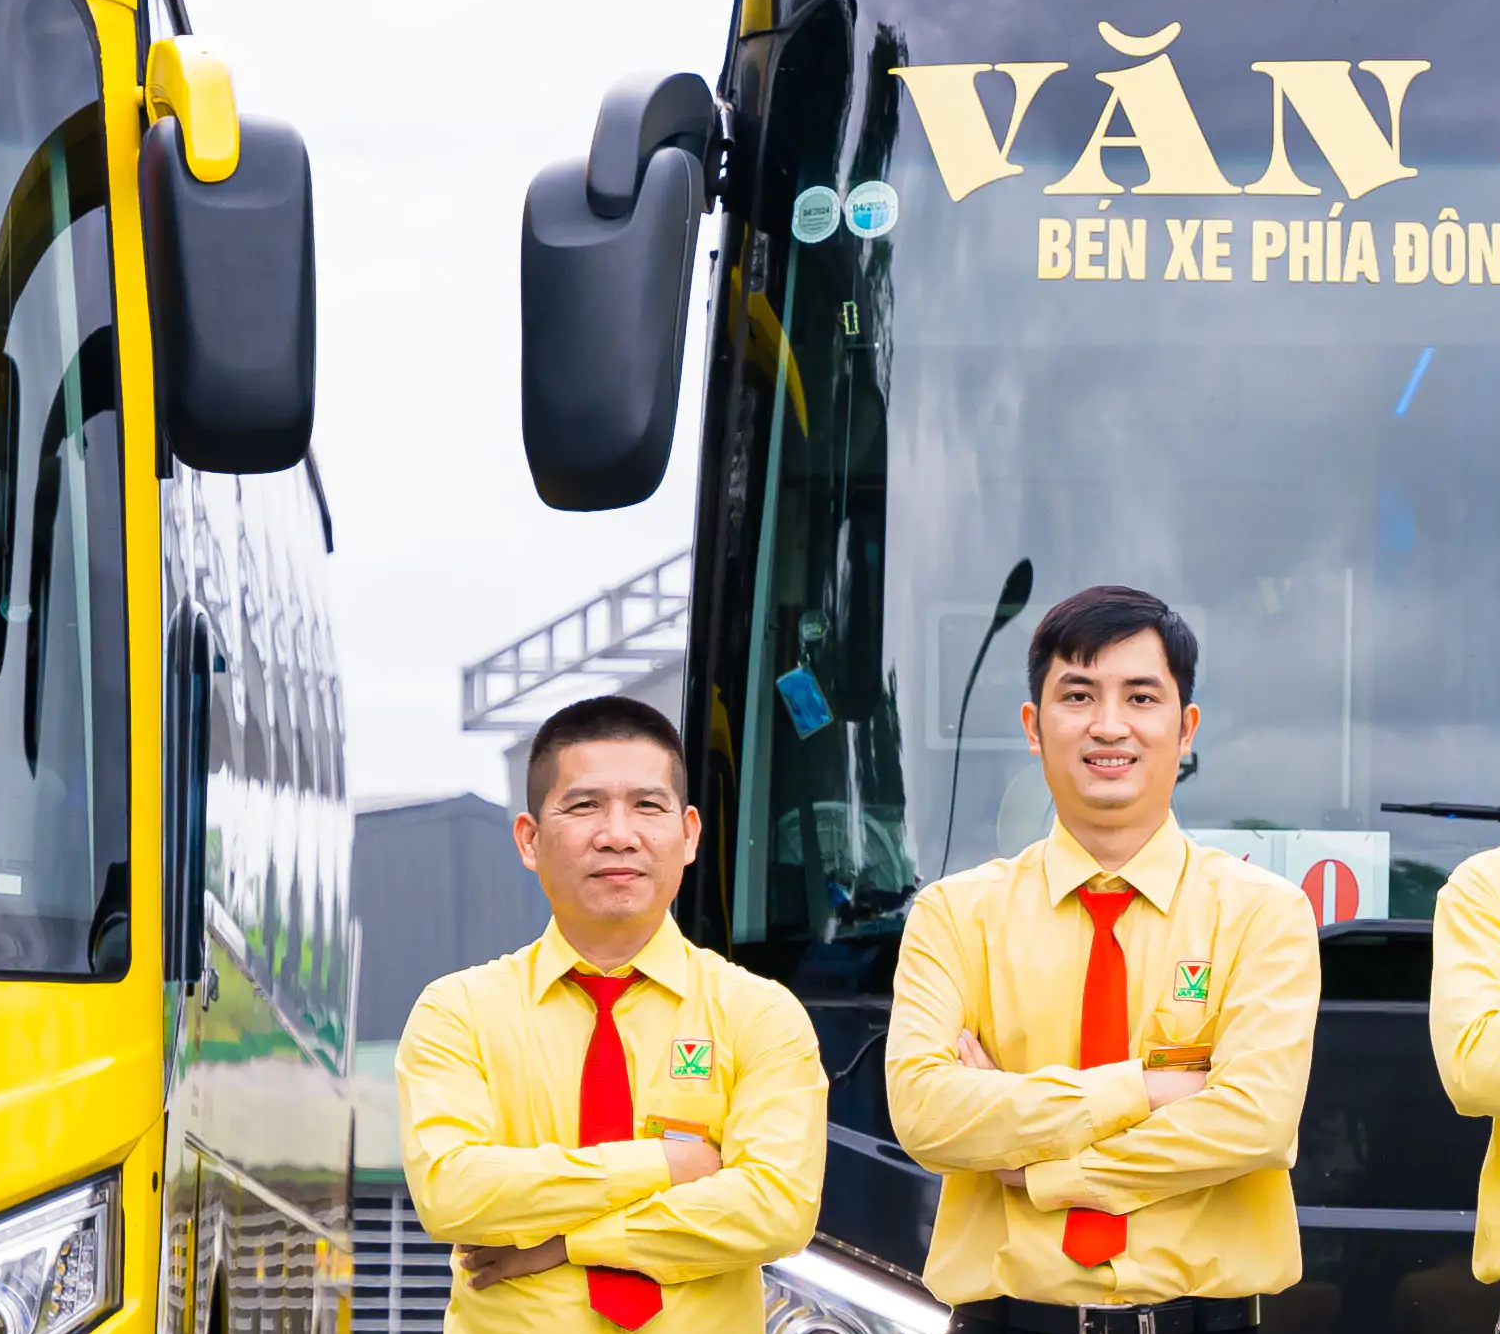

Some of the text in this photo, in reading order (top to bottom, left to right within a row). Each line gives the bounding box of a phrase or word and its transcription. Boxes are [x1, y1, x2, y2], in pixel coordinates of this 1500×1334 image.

[888, 21, 1432, 202] VĂN
[1163, 219, 1233, 281] XE
[1251, 202, 1379, 283] PHÍA
